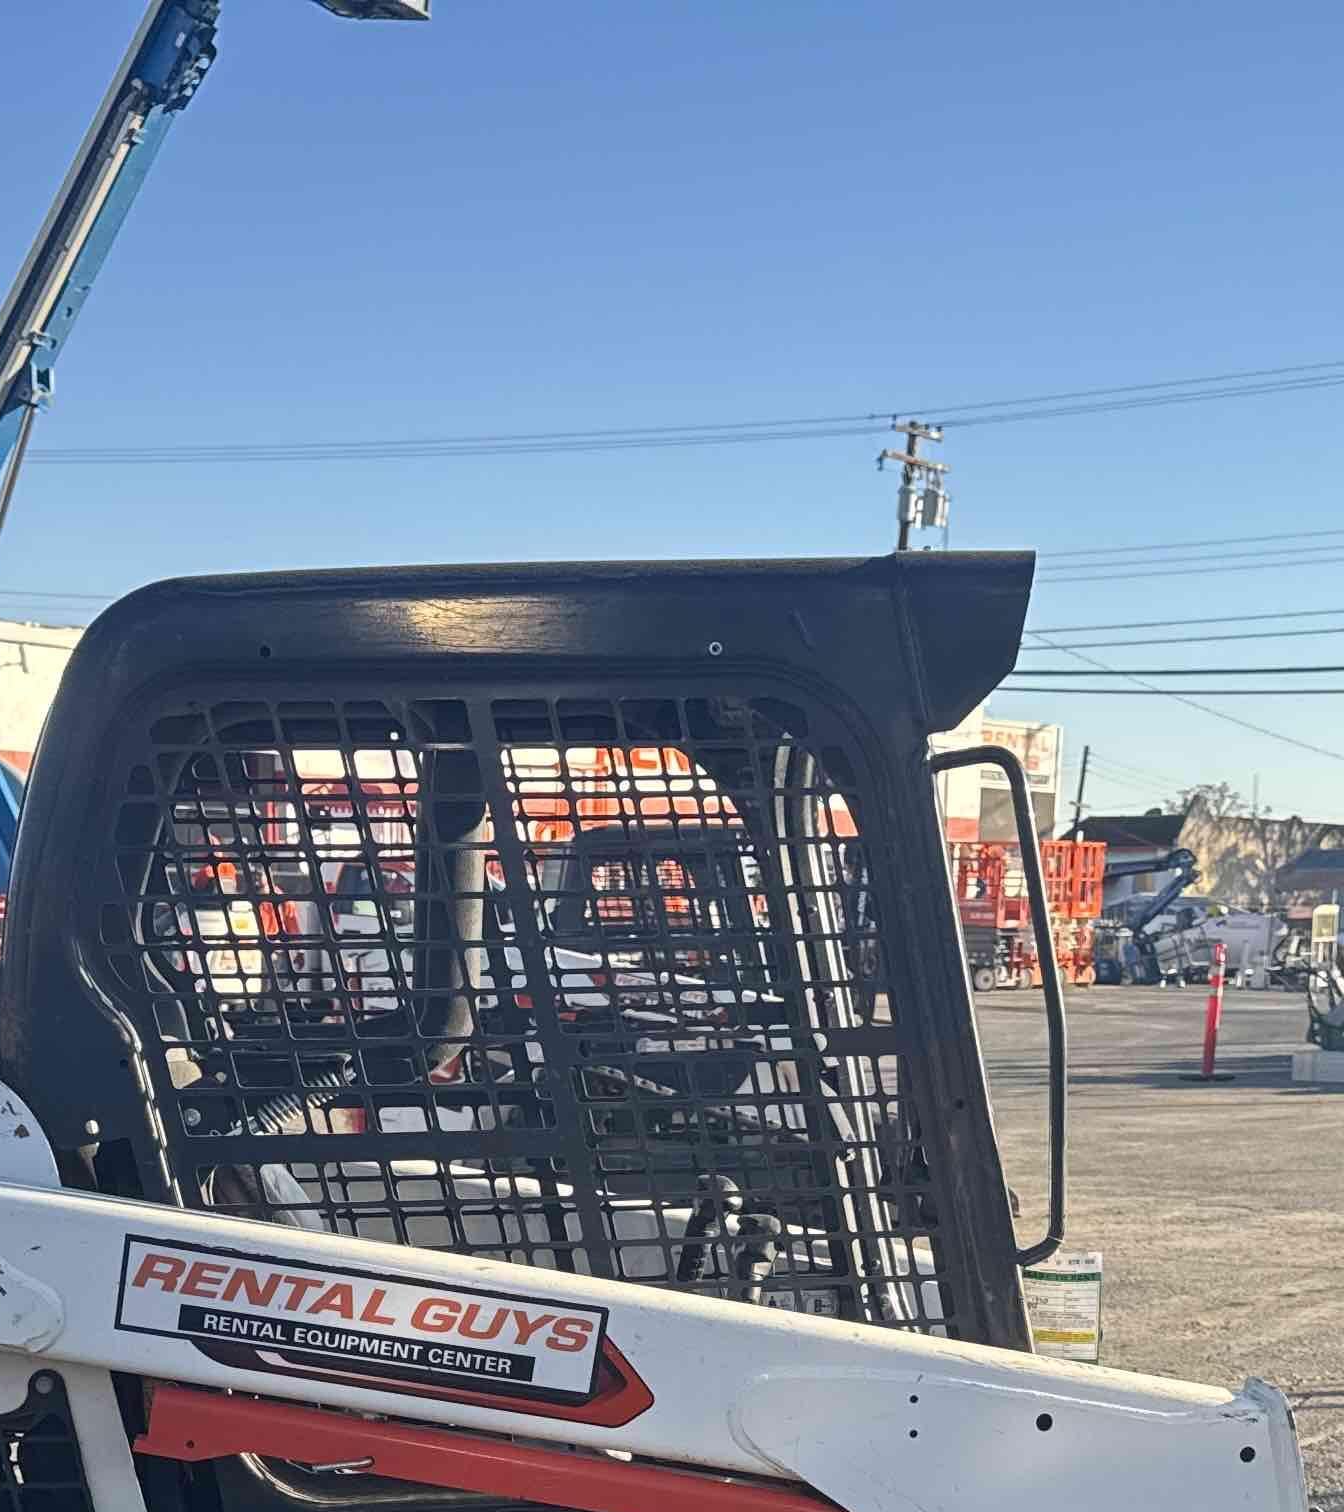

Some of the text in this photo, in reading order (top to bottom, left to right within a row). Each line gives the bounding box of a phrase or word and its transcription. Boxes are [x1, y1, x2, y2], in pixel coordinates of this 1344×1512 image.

[132, 1253, 593, 1352] RENTAL GUYS
[204, 1313, 512, 1374] RENTAL EQUIPMENT CENTER
